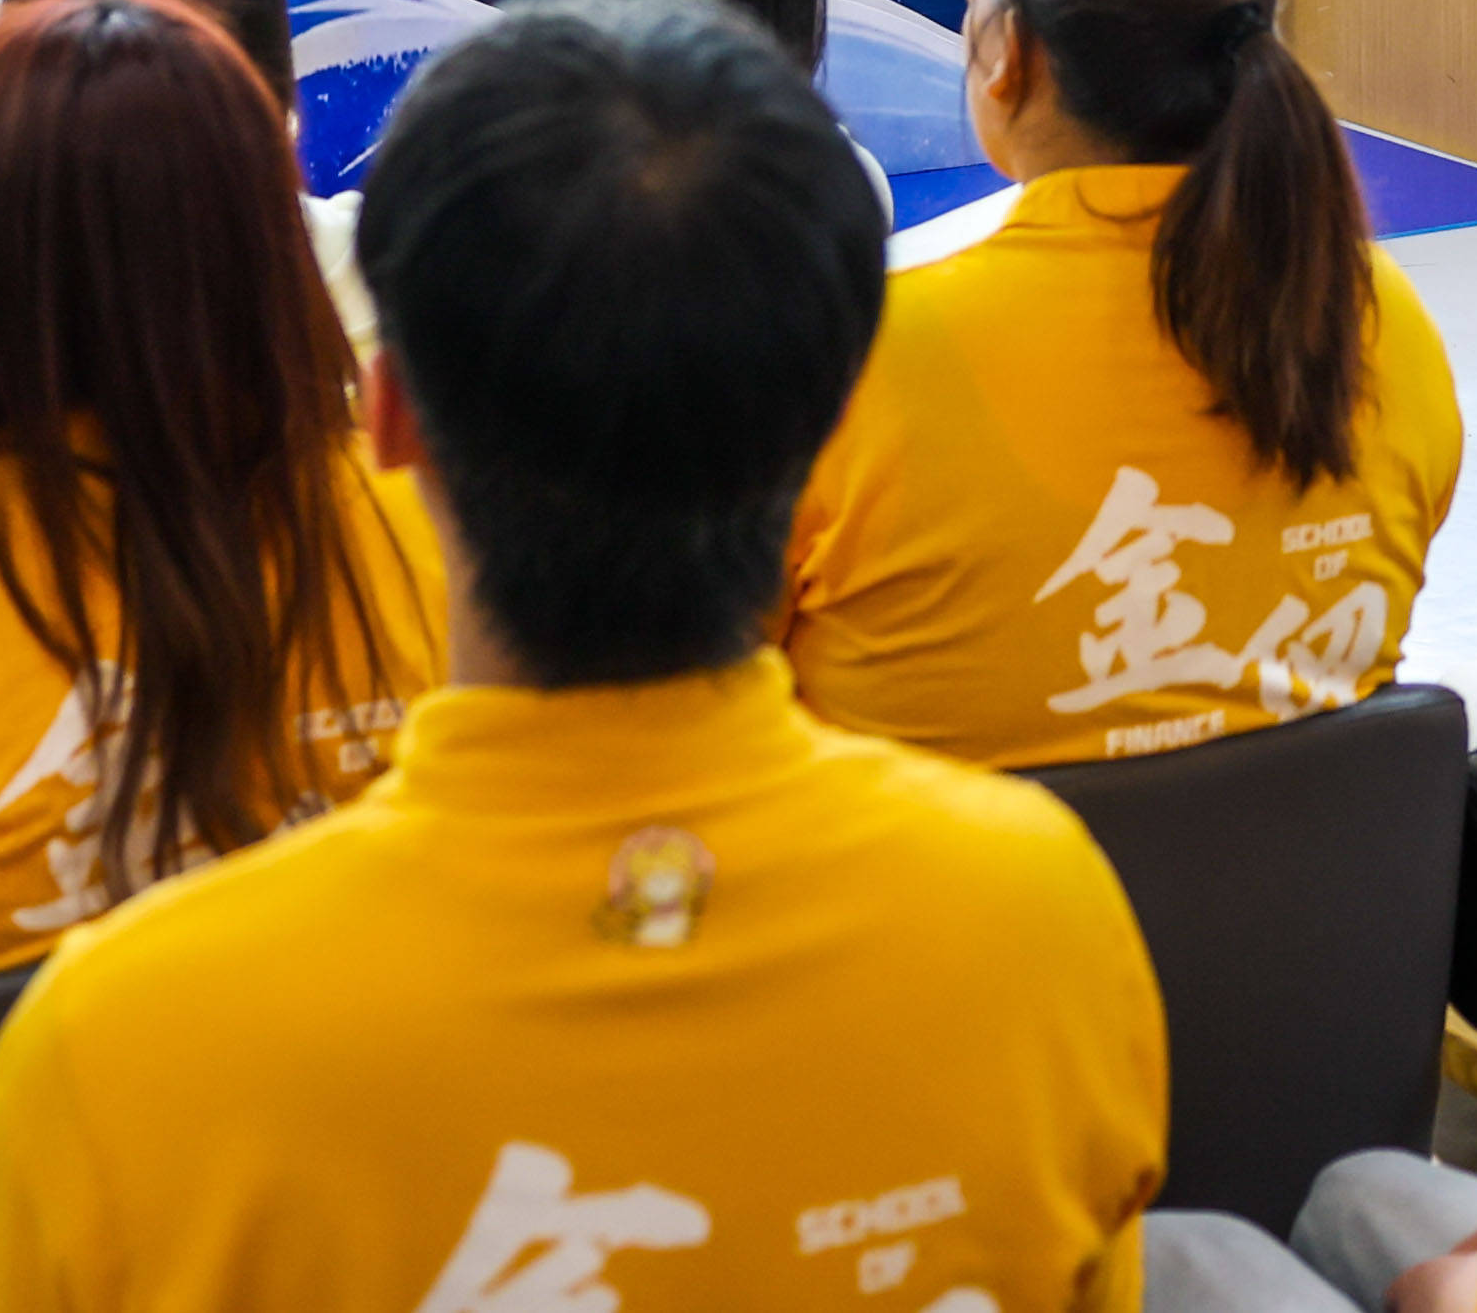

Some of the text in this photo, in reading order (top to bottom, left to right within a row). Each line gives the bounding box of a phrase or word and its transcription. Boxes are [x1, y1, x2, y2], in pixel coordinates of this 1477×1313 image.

[1281, 513, 1374, 554] SCHOOL
[1314, 550, 1349, 581] OF
[1105, 710, 1226, 758] FINANCE
